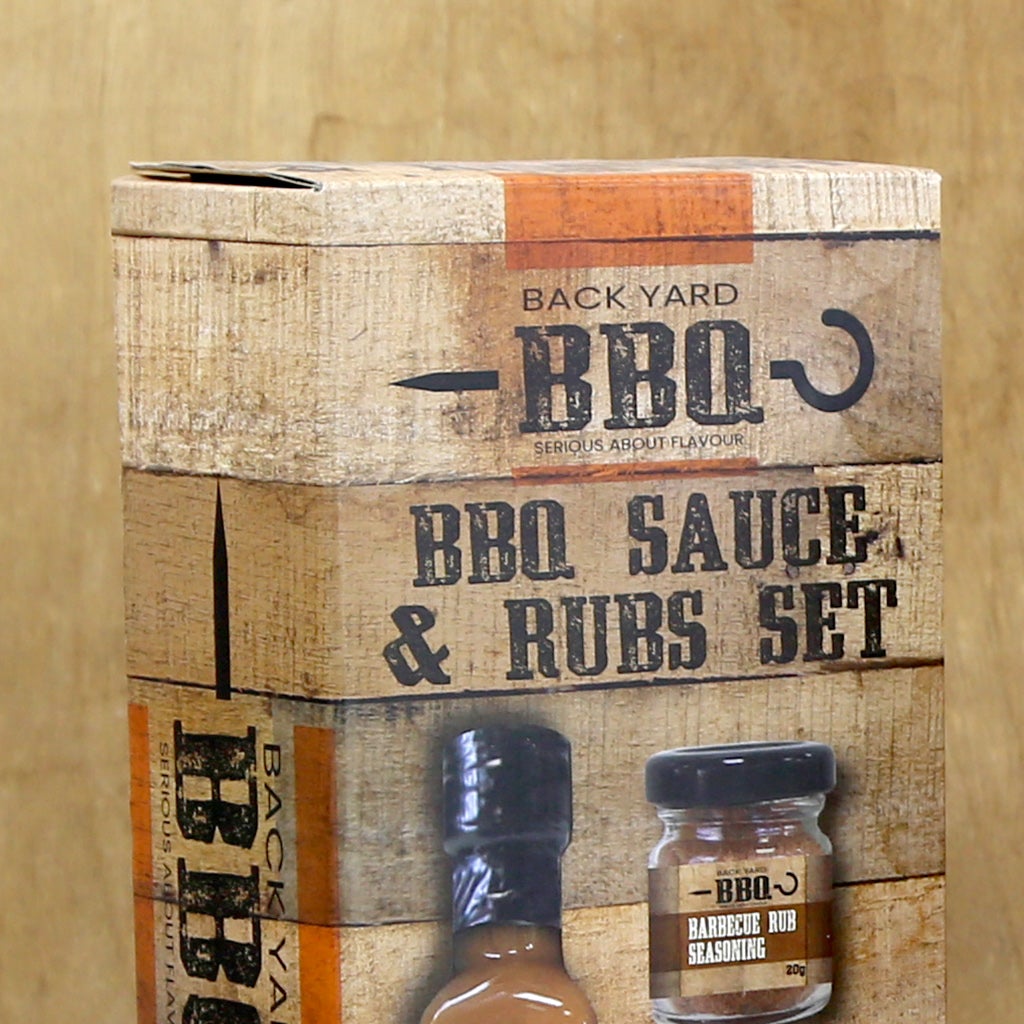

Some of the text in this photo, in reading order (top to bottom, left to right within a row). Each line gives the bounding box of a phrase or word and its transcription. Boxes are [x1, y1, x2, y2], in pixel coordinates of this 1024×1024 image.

[522, 283, 739, 312] BACK YARD
[514, 319, 764, 433] BBQ
[534, 433, 744, 455] SERIOUS ABOUT FLAVOUR
[410, 485, 868, 587] BBQ SAUCE
[382, 578, 898, 686] & RUBS SET
[159, 742, 173, 854] SERIOUS
[263, 743, 286, 915] BACK
[715, 875, 772, 904] BBQ
[688, 909, 797, 940] BARBECUE RUB
[688, 937, 766, 965] SEASONING
[786, 964, 806, 976] 20g
